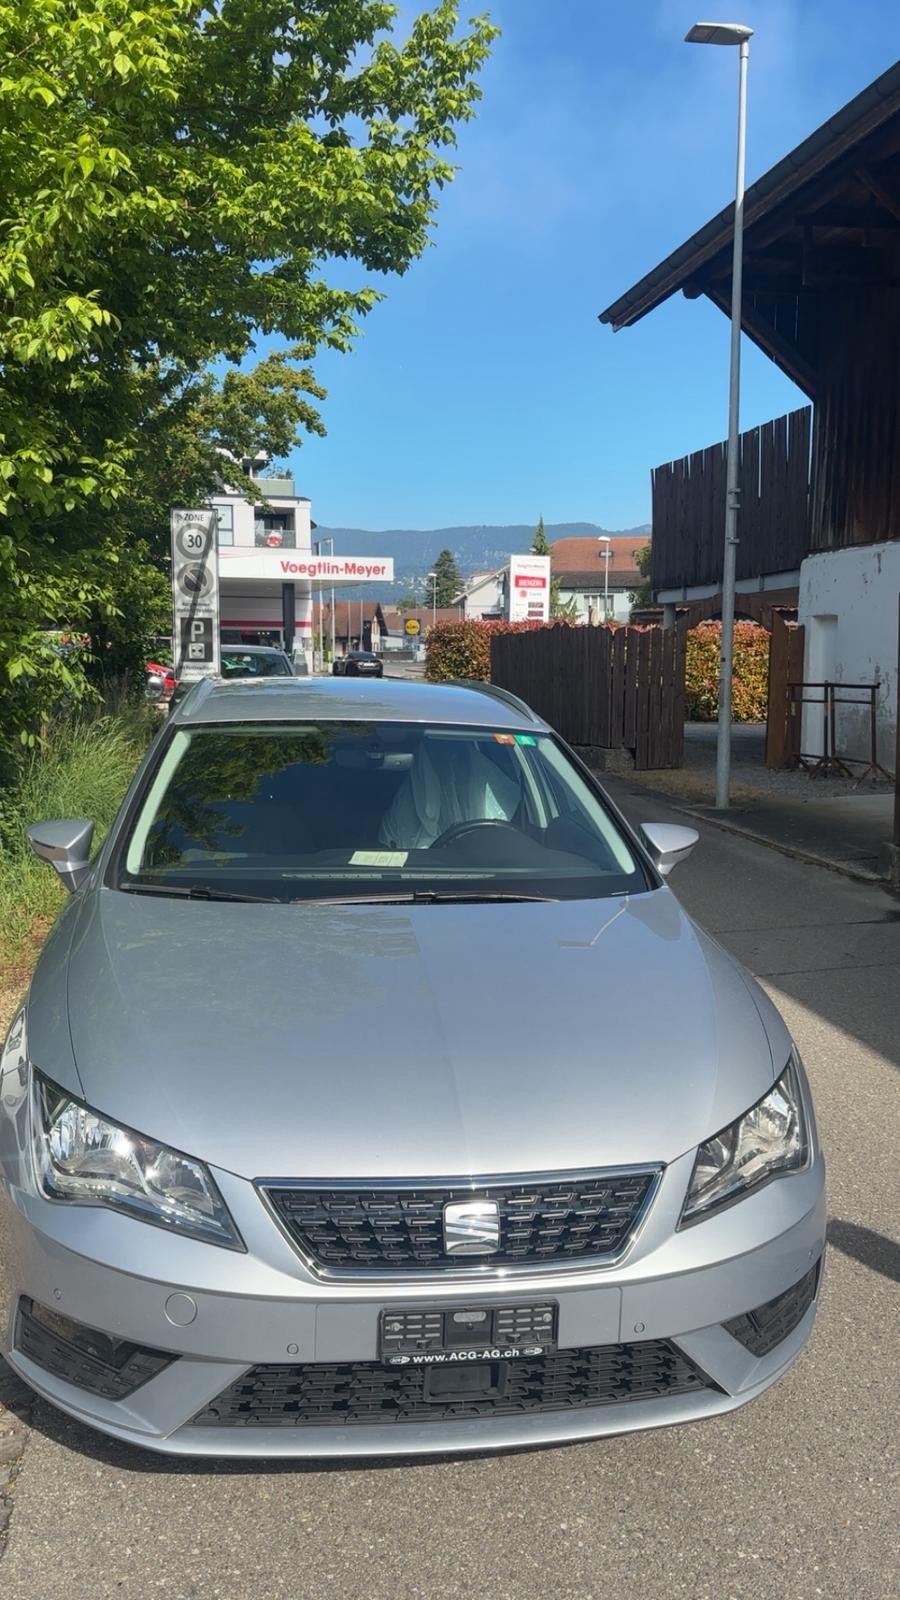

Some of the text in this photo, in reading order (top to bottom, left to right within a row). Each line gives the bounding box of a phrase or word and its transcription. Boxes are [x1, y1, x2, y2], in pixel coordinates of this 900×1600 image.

[184, 513, 204, 521] ZONE
[187, 534, 203, 548] 30
[280, 560, 387, 577] Voegtlin-Meyer
[190, 620, 205, 642] P
[412, 1347, 520, 1364] www.ACG-AG.ch
